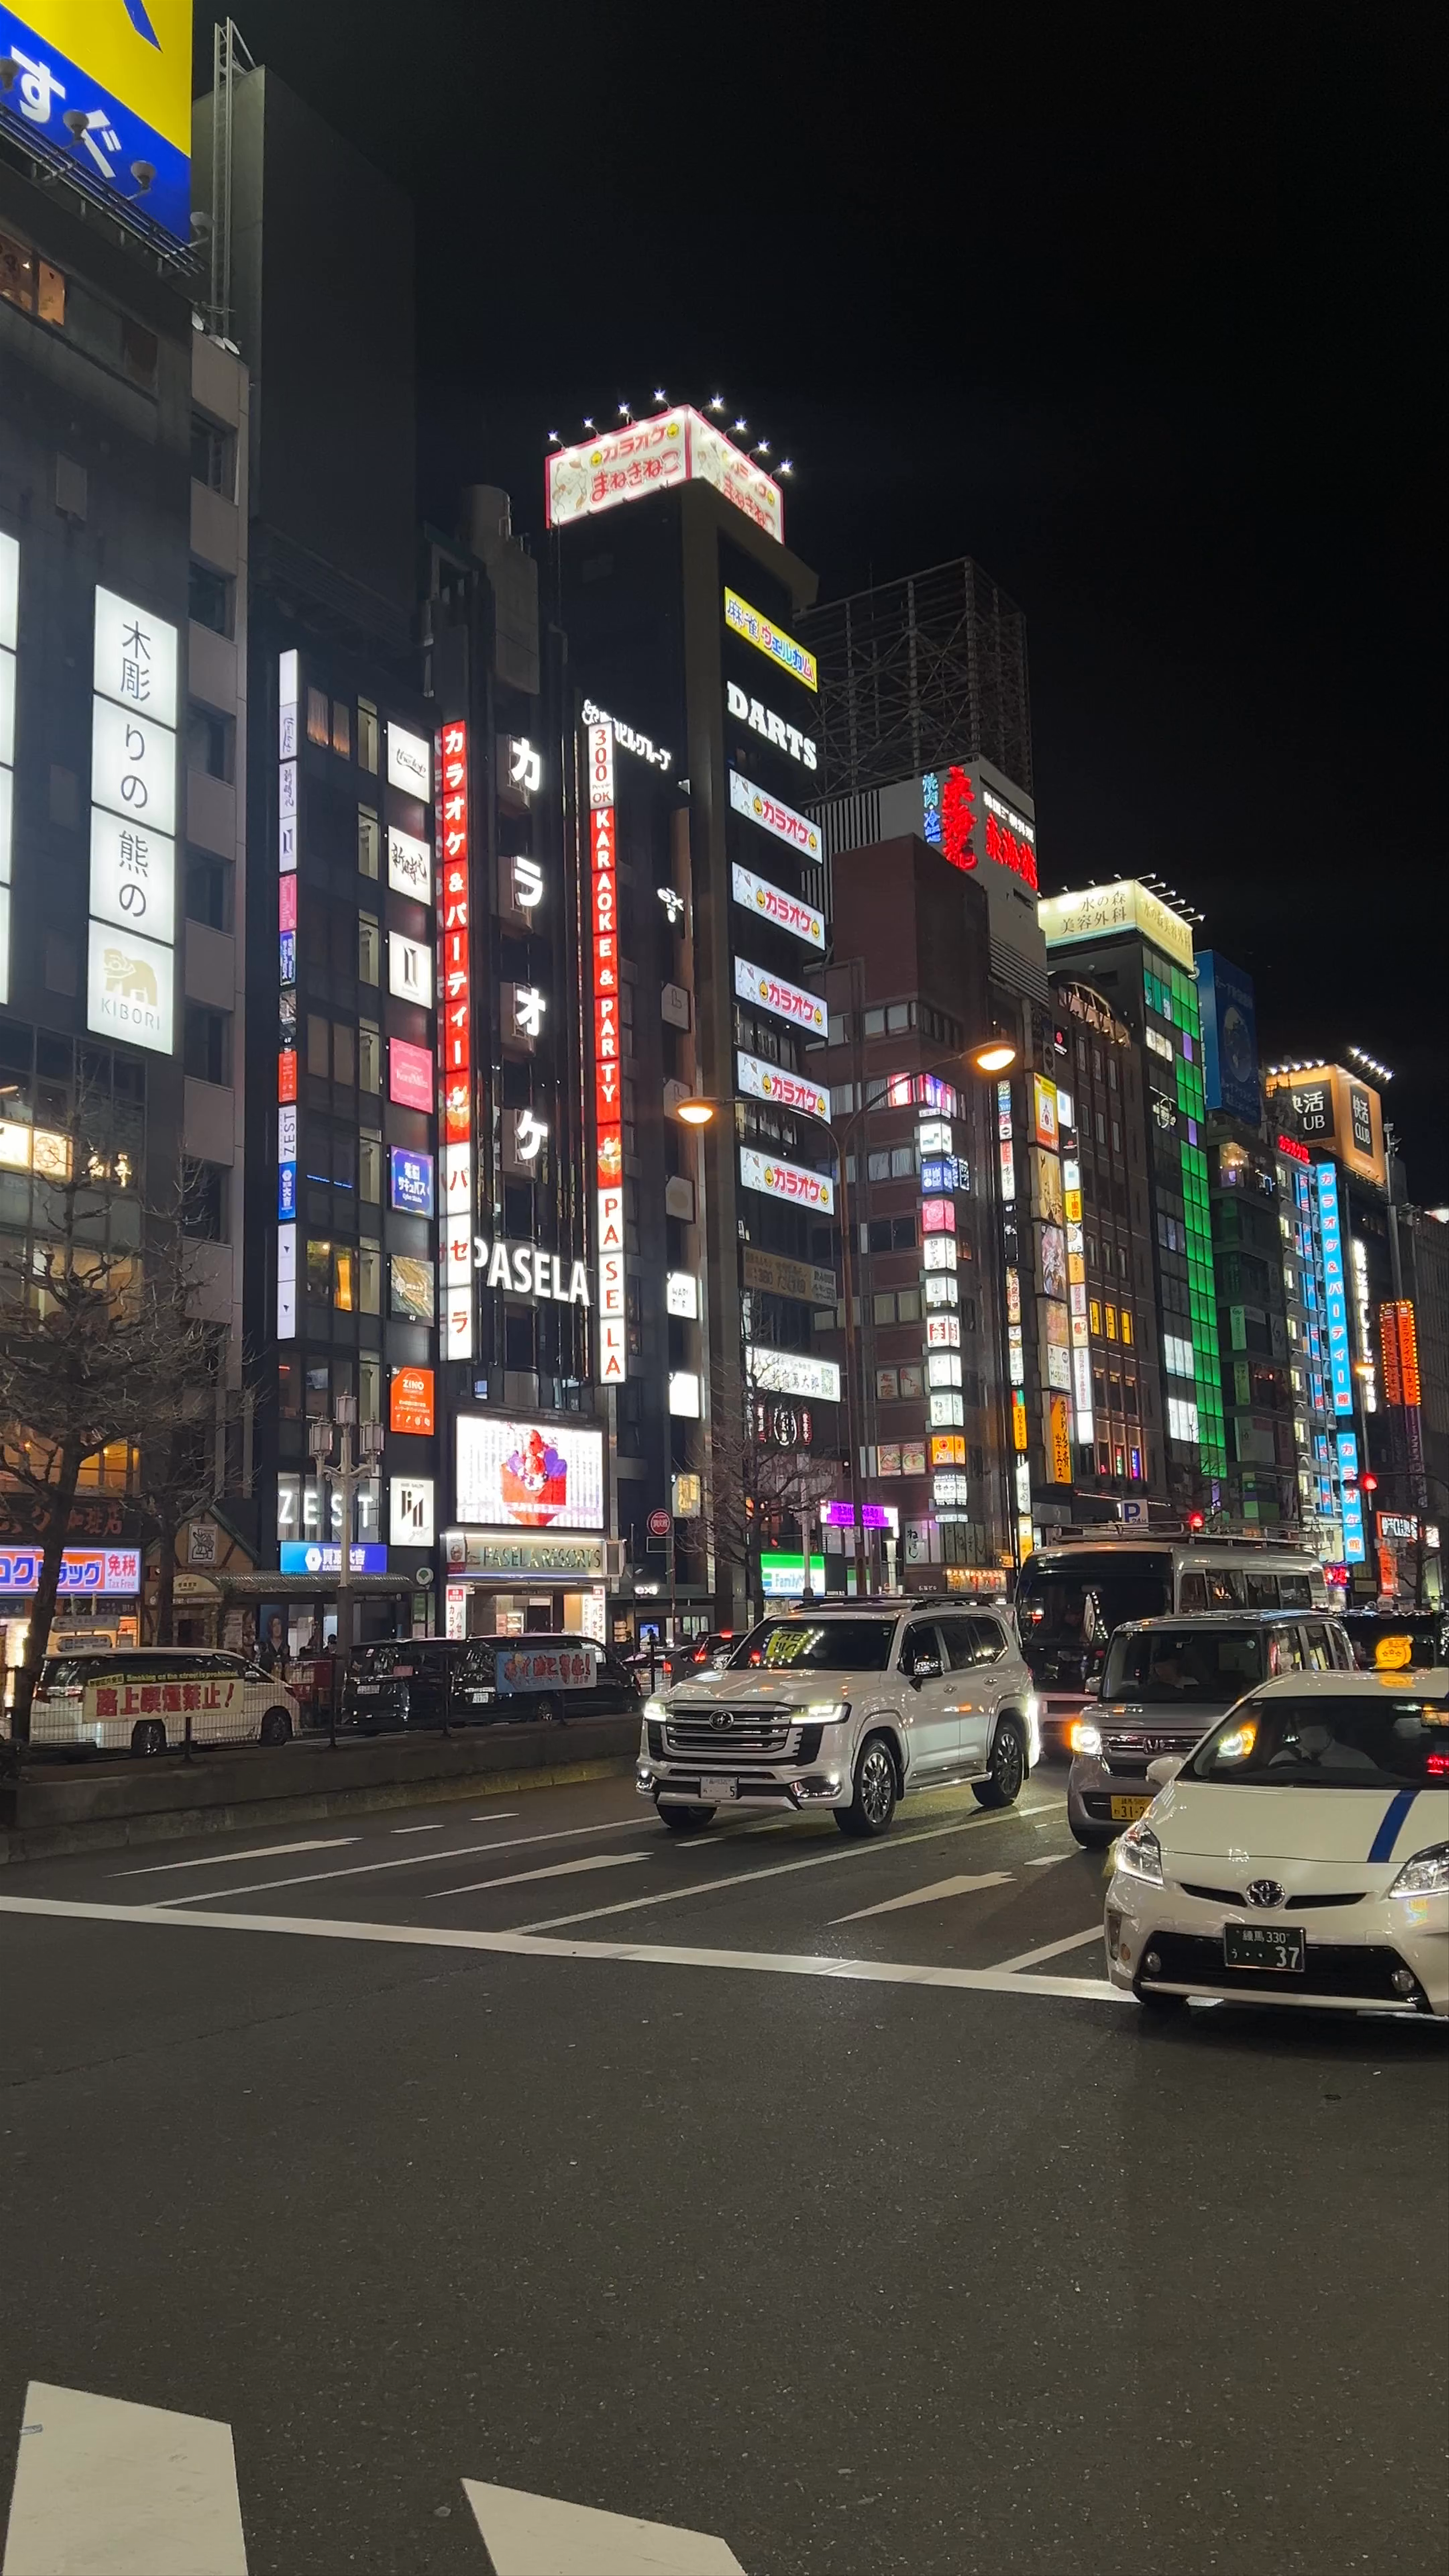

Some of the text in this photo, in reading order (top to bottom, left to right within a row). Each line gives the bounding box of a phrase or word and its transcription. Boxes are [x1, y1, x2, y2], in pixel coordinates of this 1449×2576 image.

[603, 424, 668, 465] カラオケ
[590, 450, 681, 504] まねきねこ
[723, 473, 776, 531] まねきねこ
[727, 598, 758, 640] 麻雀
[727, 681, 817, 770] DARTS
[118, 621, 151, 917] 木彫りの熊の
[595, 729, 607, 781] 300
[592, 791, 611, 804] OK
[762, 800, 809, 845] カラオケ
[765, 890, 811, 935] カラオケ
[1060, 905, 1127, 935] 美容外科
[1081, 890, 1126, 913] 水の森
[511, 736, 548, 1161] カラオケ
[595, 810, 617, 1103] KARAOKE & PARTY
[101, 997, 161, 1031] KIBORI
[768, 982, 815, 1023] カラオケ
[771, 1074, 817, 1113] カラオケ
[284, 1113, 295, 1156] ZEST
[1303, 1115, 1325, 1131] UB
[1355, 1122, 1372, 1144] CLUB
[774, 1166, 821, 1203] カラオケ
[449, 1166, 469, 1333] パセラ
[604, 1198, 621, 1375] PASELA
[279, 1490, 374, 1528] ZEST
[1124, 1503, 1140, 1523] P
[483, 1546, 601, 1568] PASELA RESORTS
[906, 1529, 918, 1559] ねぎし
[108, 1553, 137, 1577] 免税
[108, 1578, 135, 1589] Tax Free
[126, 1673, 157, 1682] Smoking
[729, 1786, 735, 1797] 5
[1121, 1806, 1146, 1818] 31-2
[1242, 1930, 1286, 1944] 練馬 330
[1275, 1946, 1300, 1969] 37
